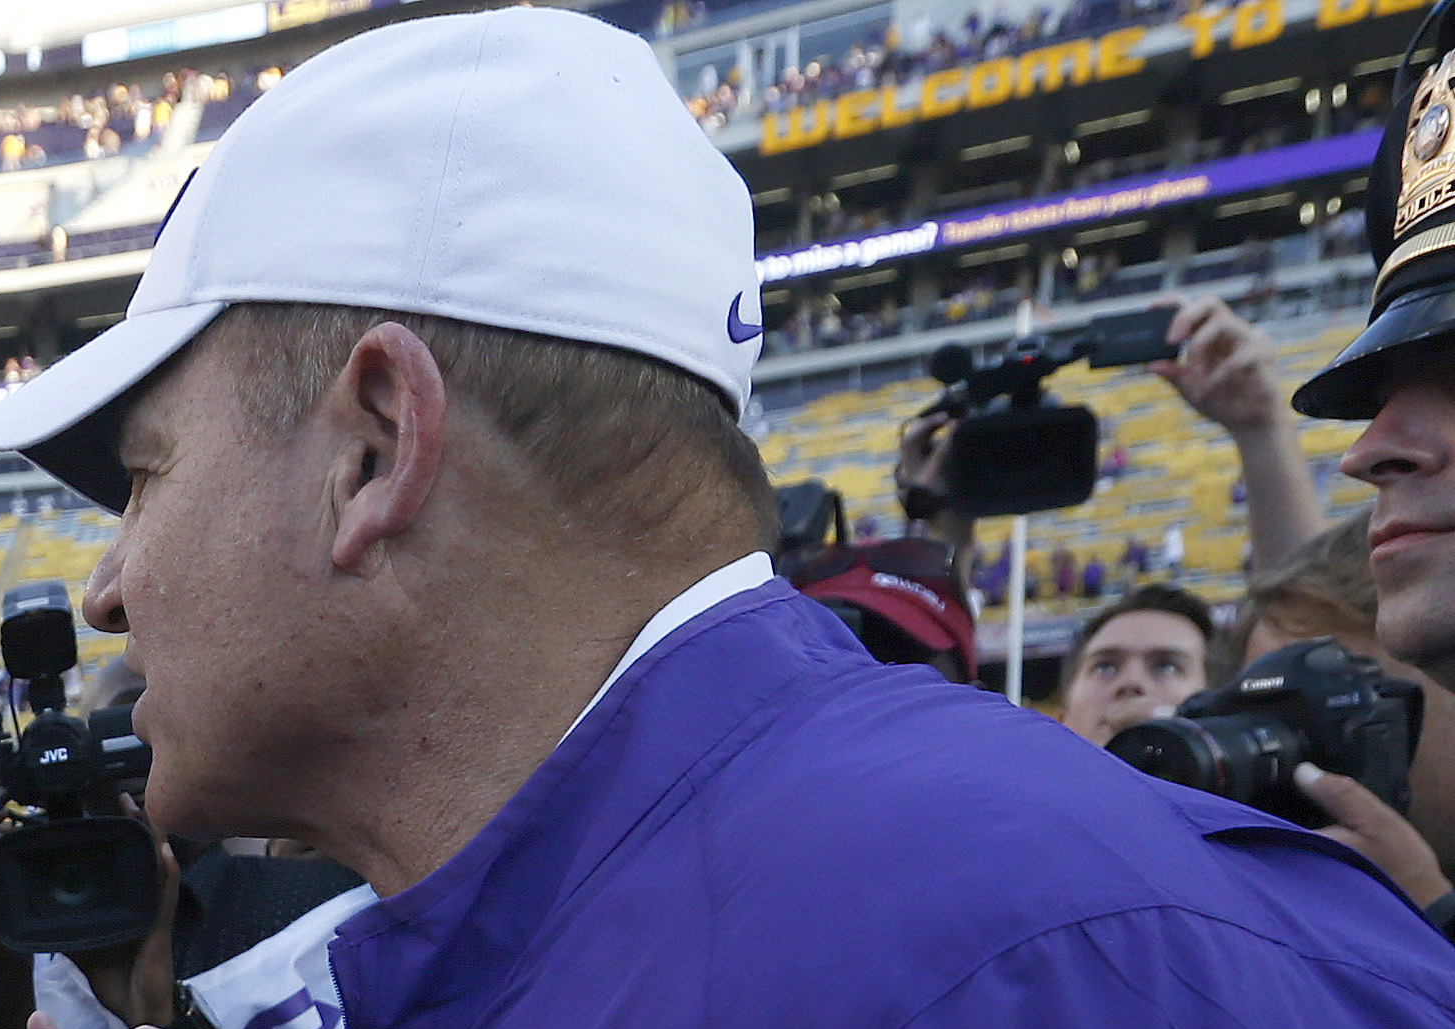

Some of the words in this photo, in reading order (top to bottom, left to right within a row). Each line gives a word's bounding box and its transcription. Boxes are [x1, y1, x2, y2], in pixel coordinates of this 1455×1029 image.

[758, 26, 1147, 155] WELCOME
[1177, 0, 1286, 60] TO
[39, 747, 68, 765] JVC
